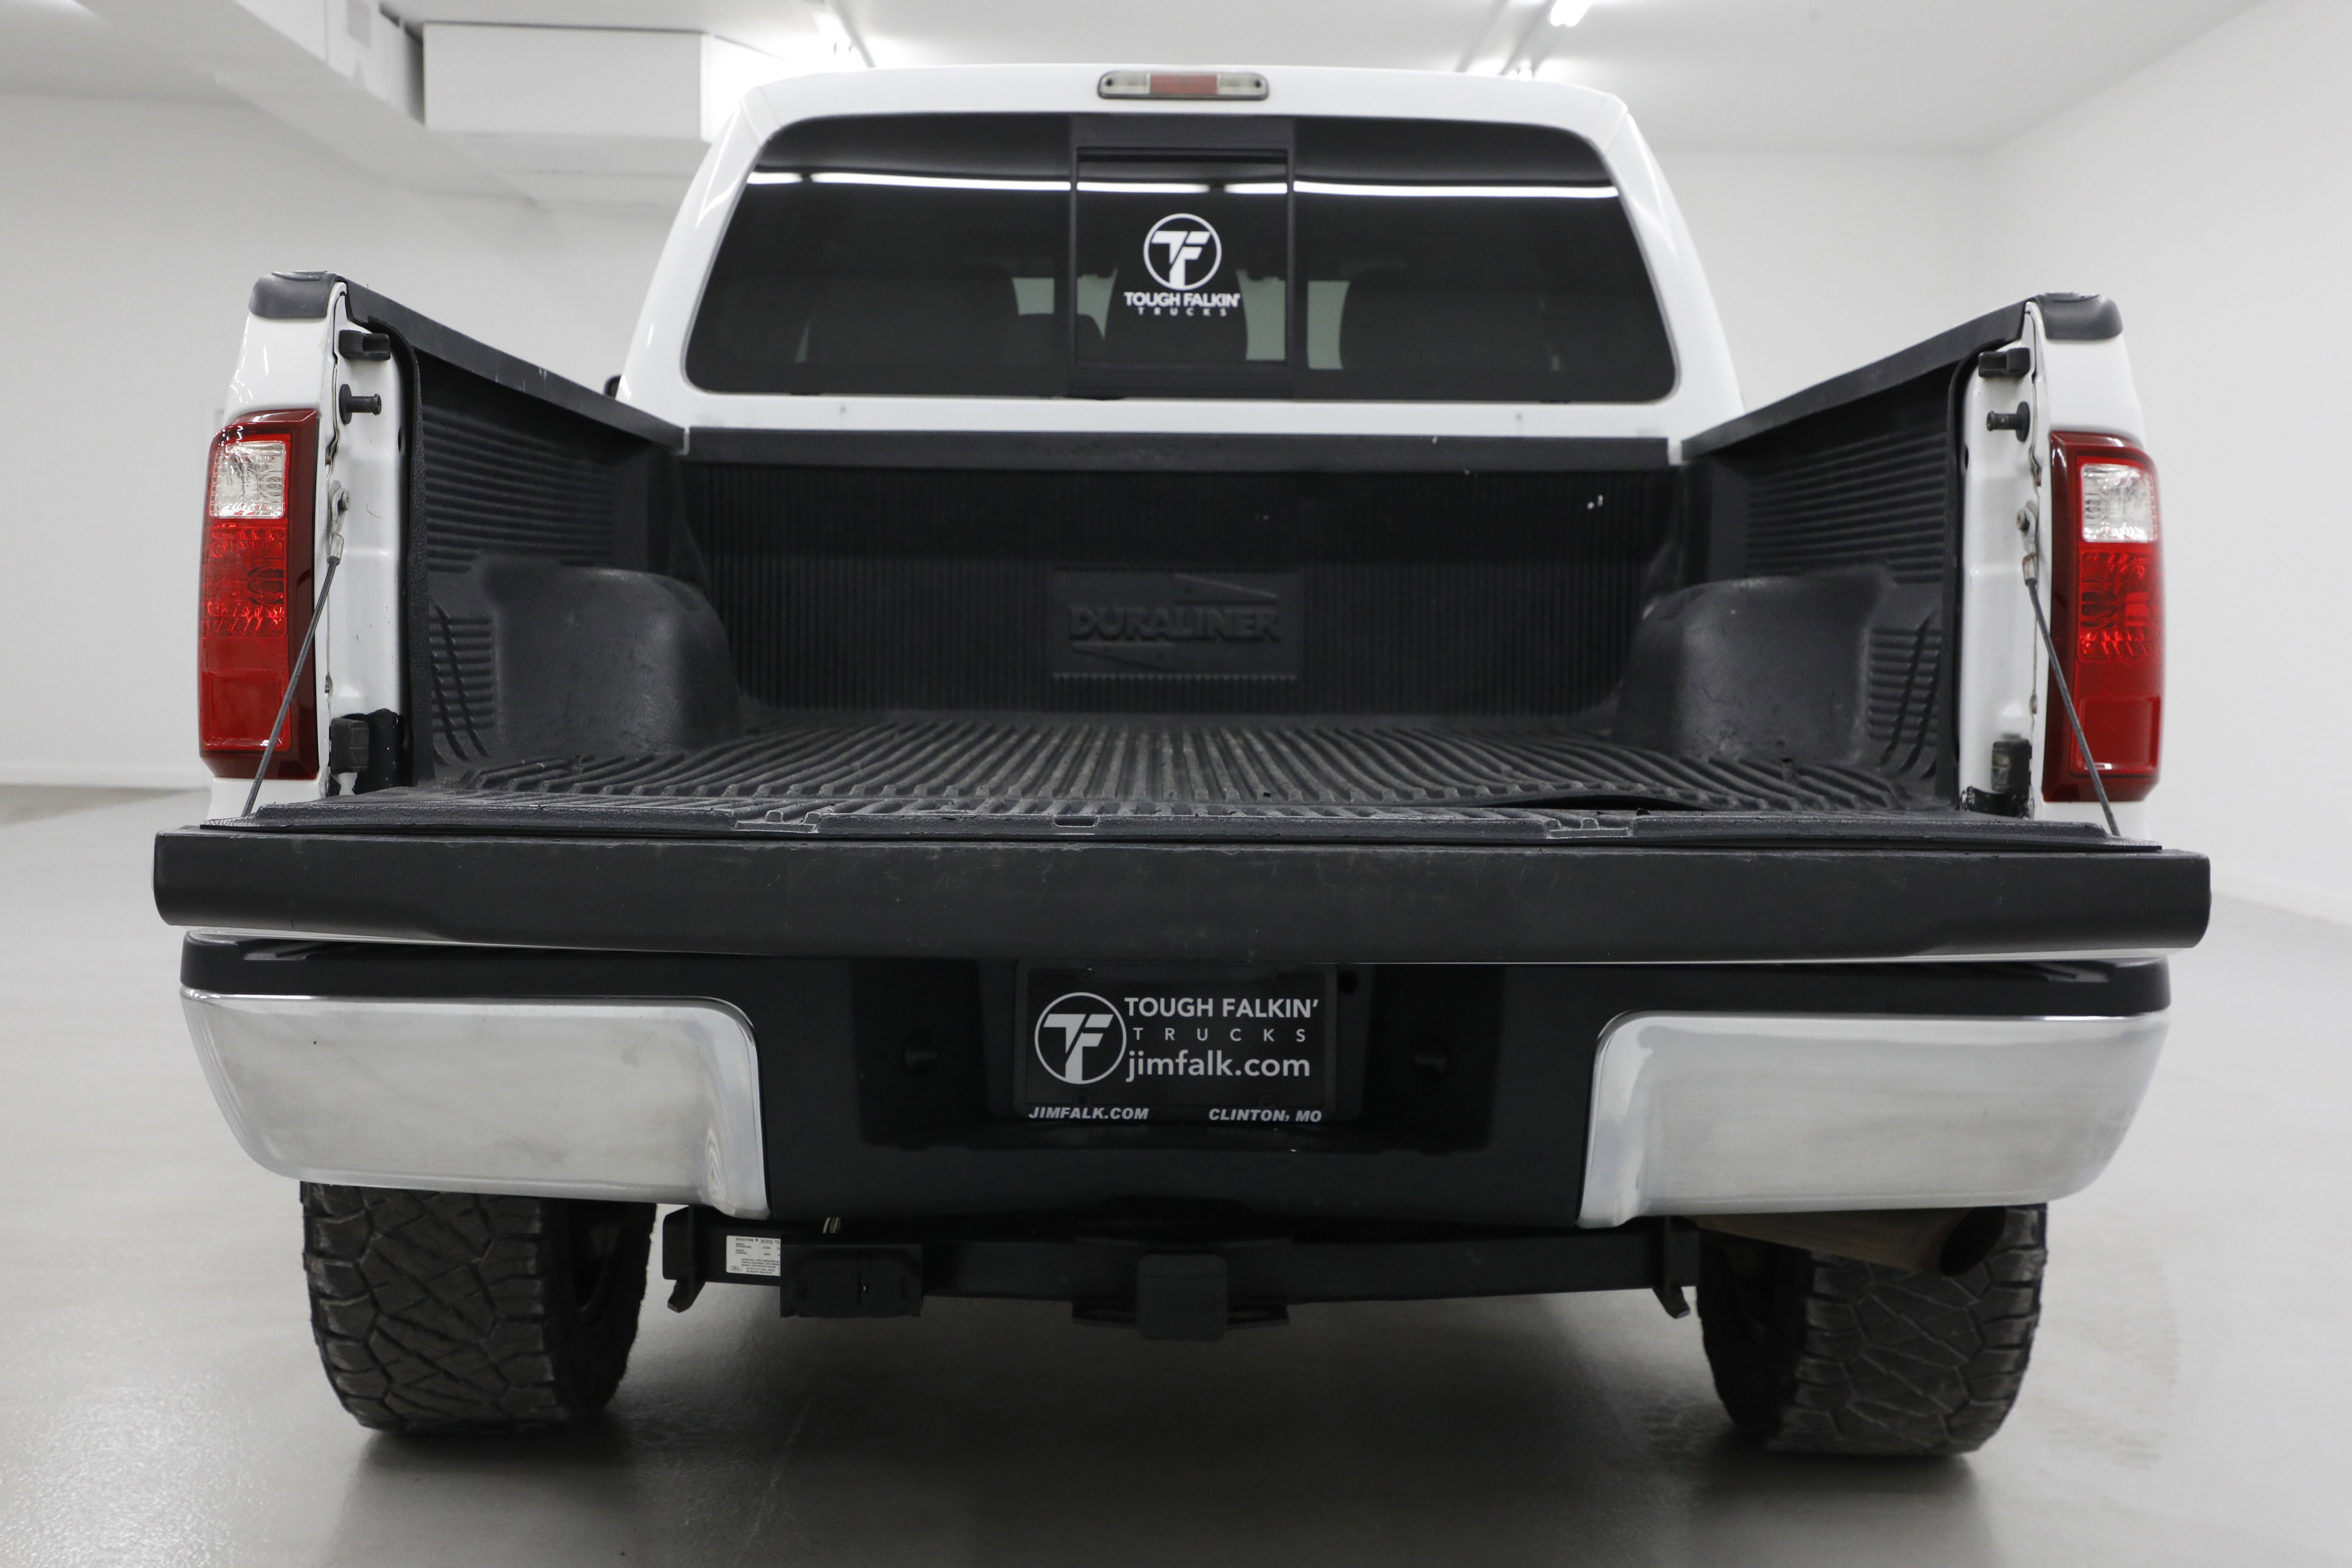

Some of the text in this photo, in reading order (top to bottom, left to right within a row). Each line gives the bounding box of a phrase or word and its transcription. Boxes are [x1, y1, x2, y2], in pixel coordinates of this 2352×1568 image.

[1124, 292, 1241, 307] TOUGH FALKIN'
[1138, 307, 1227, 316] TRUCKS
[1068, 606, 1280, 641] DURALINER
[1124, 997, 1319, 1018] TOUGH FALKIN'
[1133, 1027, 1306, 1042] TRUCKS
[1125, 1050, 1310, 1082] jimfalk.com
[1028, 1107, 1149, 1120] JIMFALK.COM
[1209, 1108, 1322, 1123] CLINTON, MO
